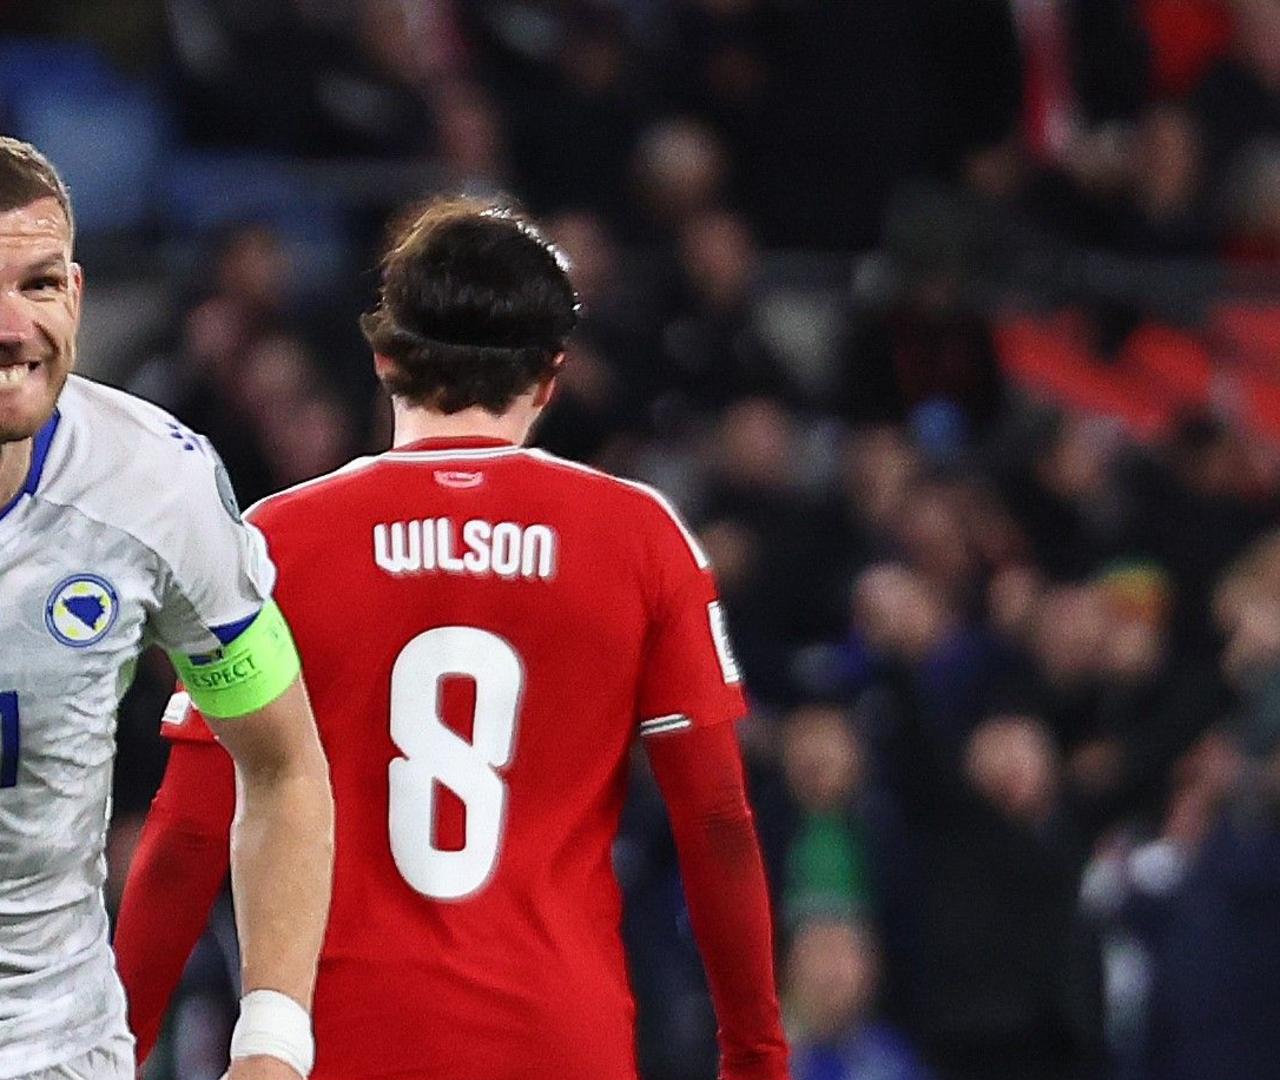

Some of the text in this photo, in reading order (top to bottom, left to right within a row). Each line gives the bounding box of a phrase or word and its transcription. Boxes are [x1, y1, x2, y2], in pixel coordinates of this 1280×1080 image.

[373, 517, 556, 578] WILSON
[189, 655, 256, 688] ESPECT
[389, 625, 522, 899] 8
